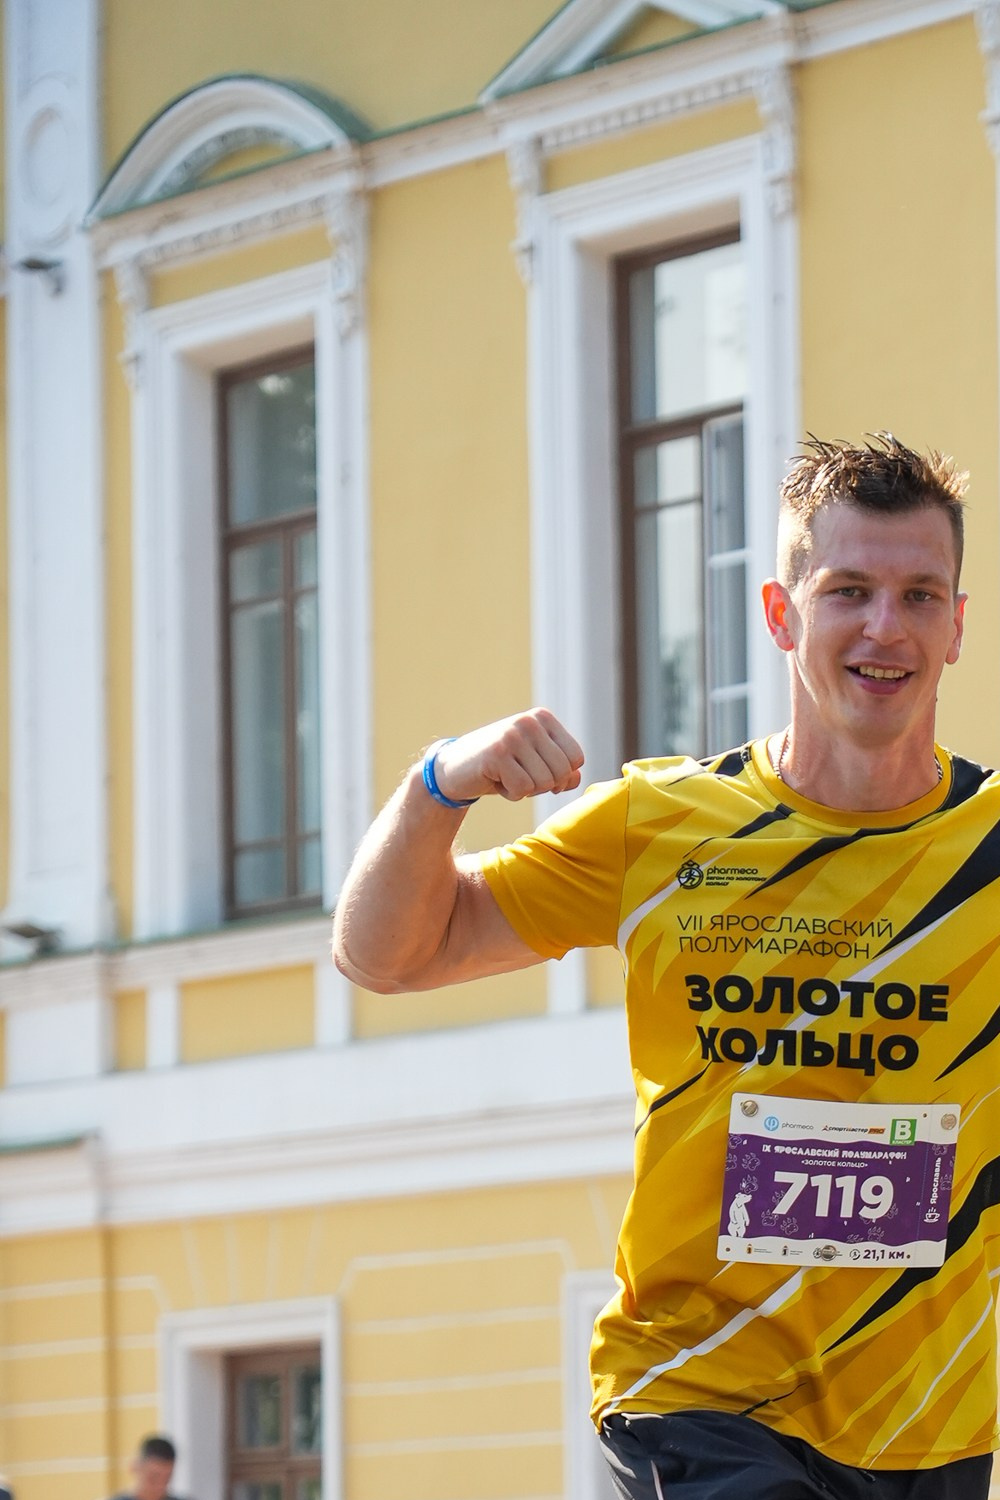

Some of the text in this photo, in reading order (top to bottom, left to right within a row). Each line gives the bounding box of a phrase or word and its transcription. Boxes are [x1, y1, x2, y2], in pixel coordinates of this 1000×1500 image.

[706, 865, 759, 875] pharmeco
[677, 914, 893, 938] VII ЯРОСЛАВСКИЙ
[679, 936, 869, 959] ПОЛУМАРАФОН
[684, 974, 949, 1022] ЗОЛОТОЕ
[695, 1025, 920, 1076] КОЛЬЦО
[781, 1121, 814, 1131] pharmeco
[774, 1145, 839, 1158] ЯРОСЛАВСКИЙ
[841, 1150, 907, 1160] ПОЛУМАРАФОН
[930, 1157, 942, 1204] Ярославль
[772, 1171, 894, 1220] 7119
[863, 1249, 885, 1261] 21,1
